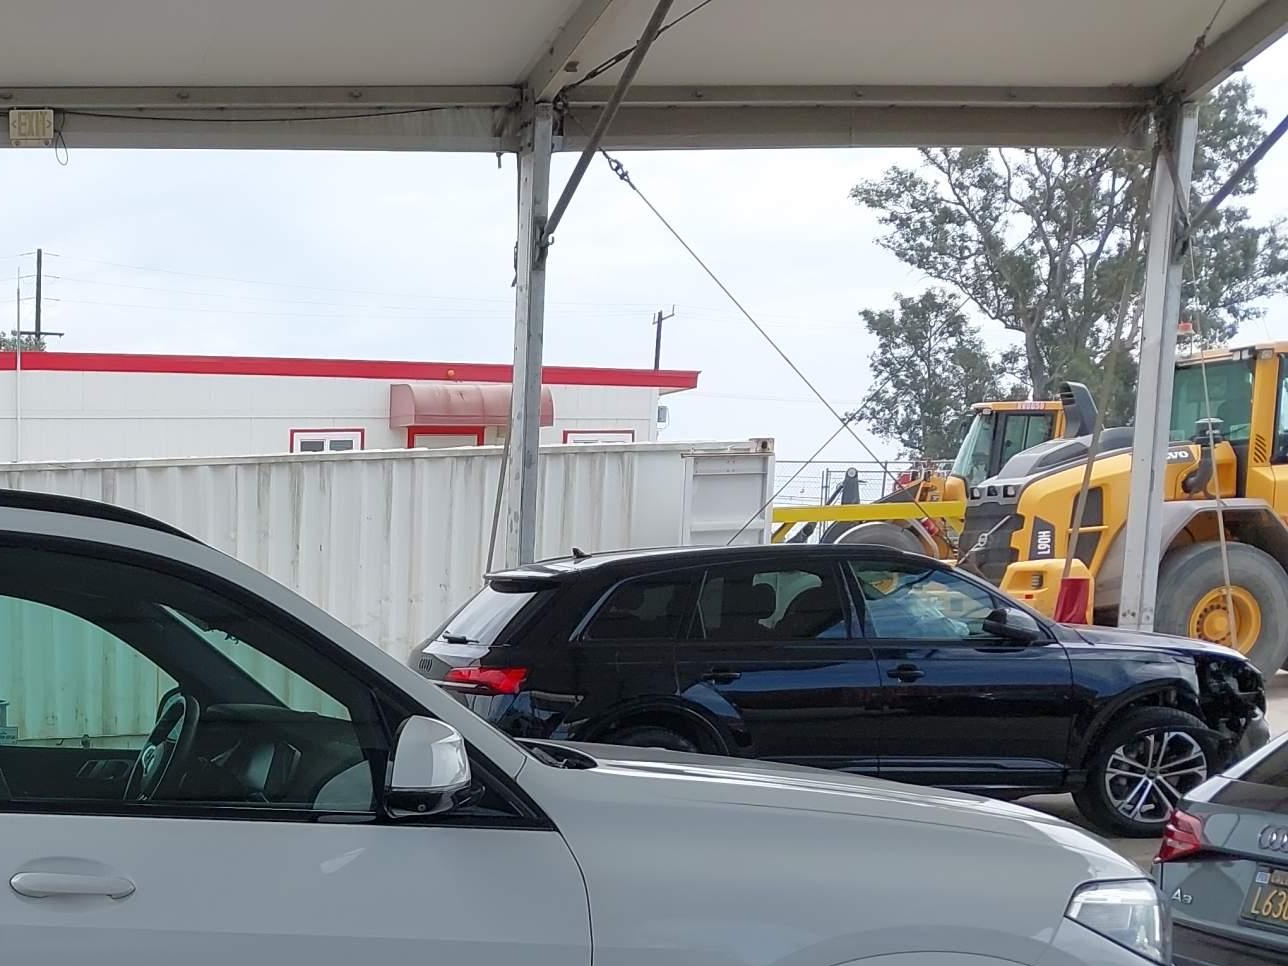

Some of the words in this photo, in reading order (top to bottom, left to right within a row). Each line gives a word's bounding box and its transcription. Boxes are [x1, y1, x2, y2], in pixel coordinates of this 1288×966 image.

[17, 111, 49, 137] EXIT
[1037, 530, 1051, 555] L90H
[1171, 888, 1193, 904] A3
